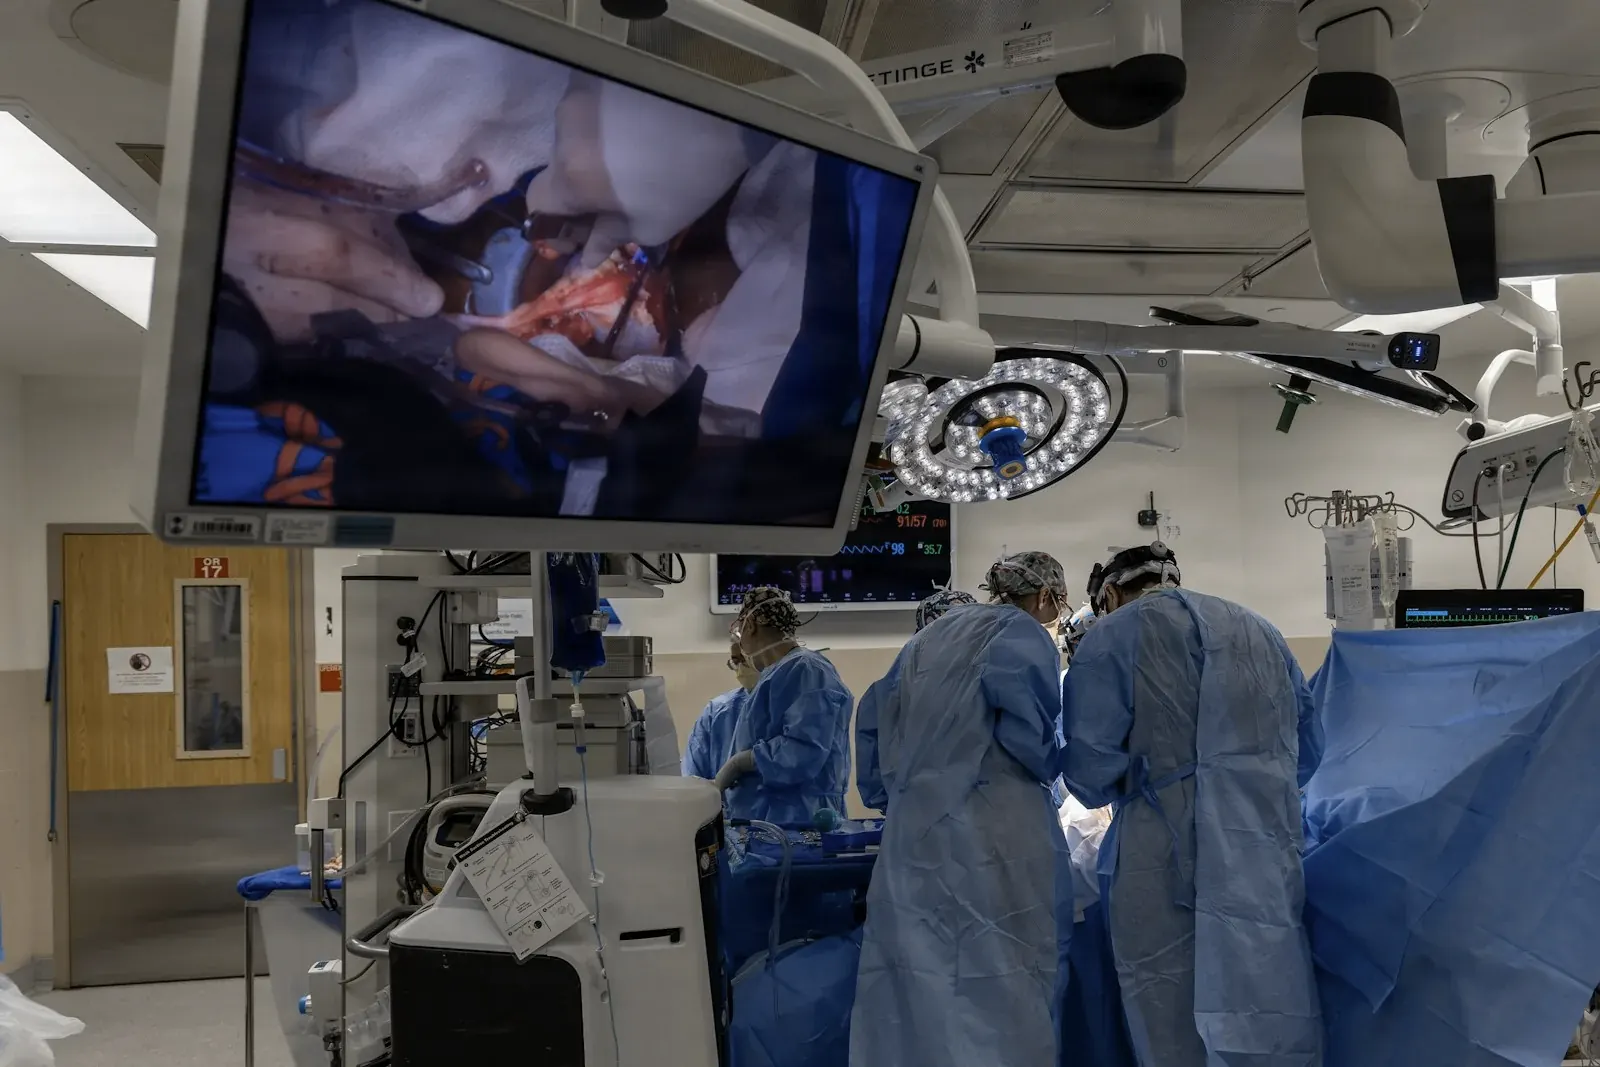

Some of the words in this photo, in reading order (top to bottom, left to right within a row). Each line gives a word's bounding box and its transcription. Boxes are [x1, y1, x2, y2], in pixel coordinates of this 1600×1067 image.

[897, 515, 927, 528] 91/57
[891, 542, 905, 555] 98
[924, 544, 942, 555] 35.7
[203, 557, 220, 566] OR
[201, 565, 222, 578] 17
